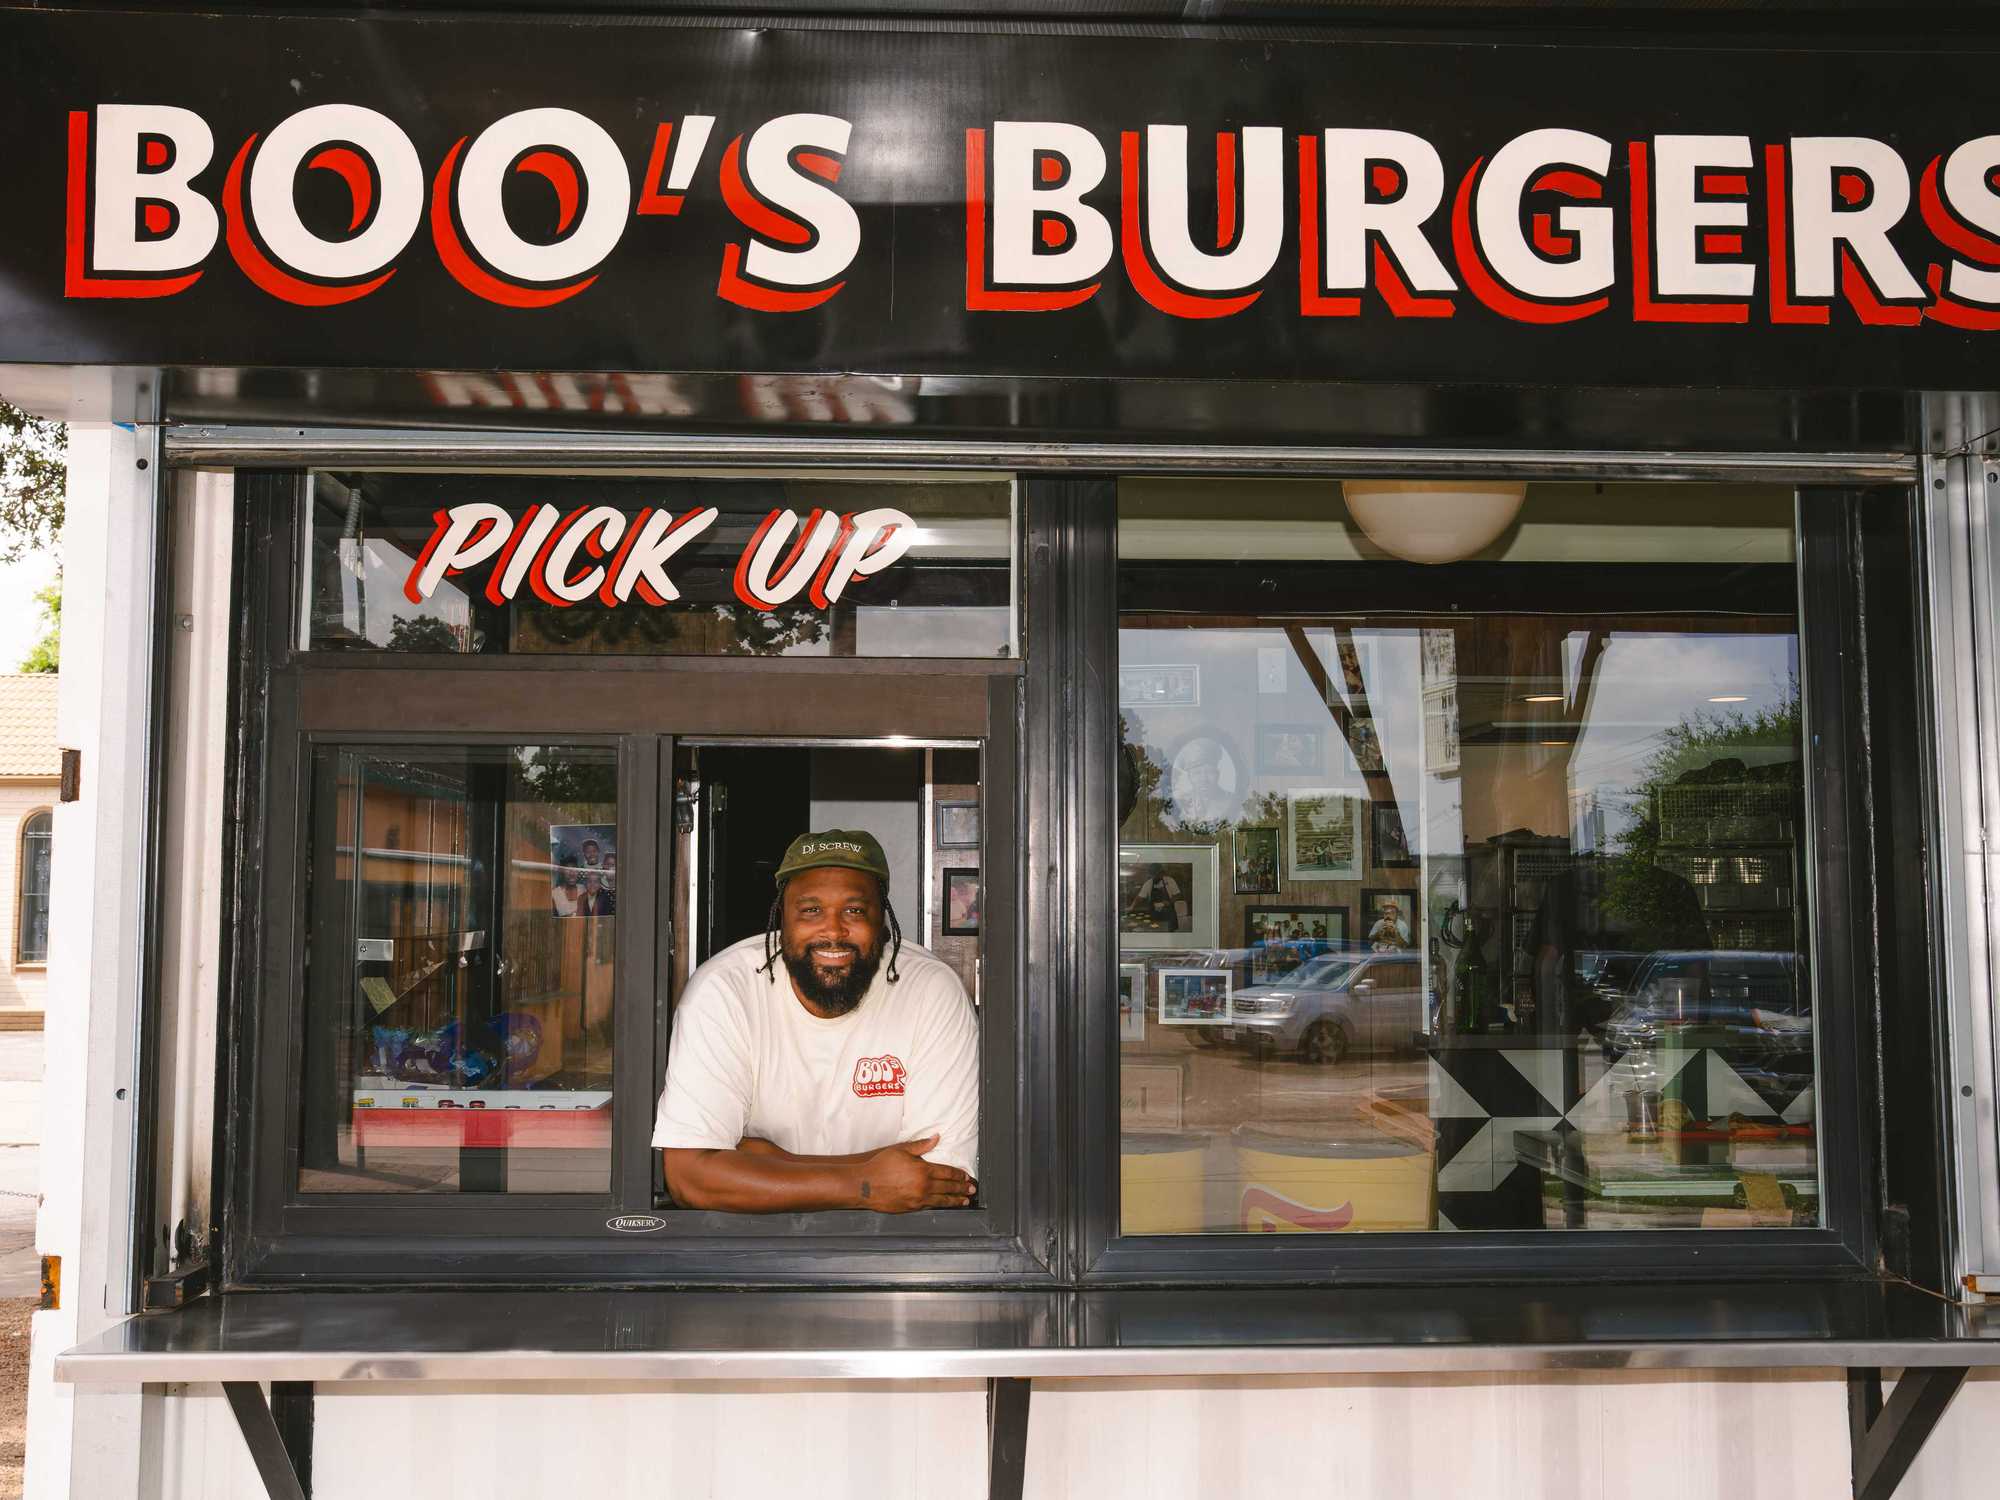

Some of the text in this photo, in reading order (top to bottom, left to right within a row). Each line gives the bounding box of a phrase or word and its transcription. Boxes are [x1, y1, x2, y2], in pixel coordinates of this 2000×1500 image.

[65, 103, 861, 312] BOO'S
[404, 503, 917, 611] PICK UP
[818, 842, 862, 854] SCREW
[855, 1082, 900, 1091] BURGERS
